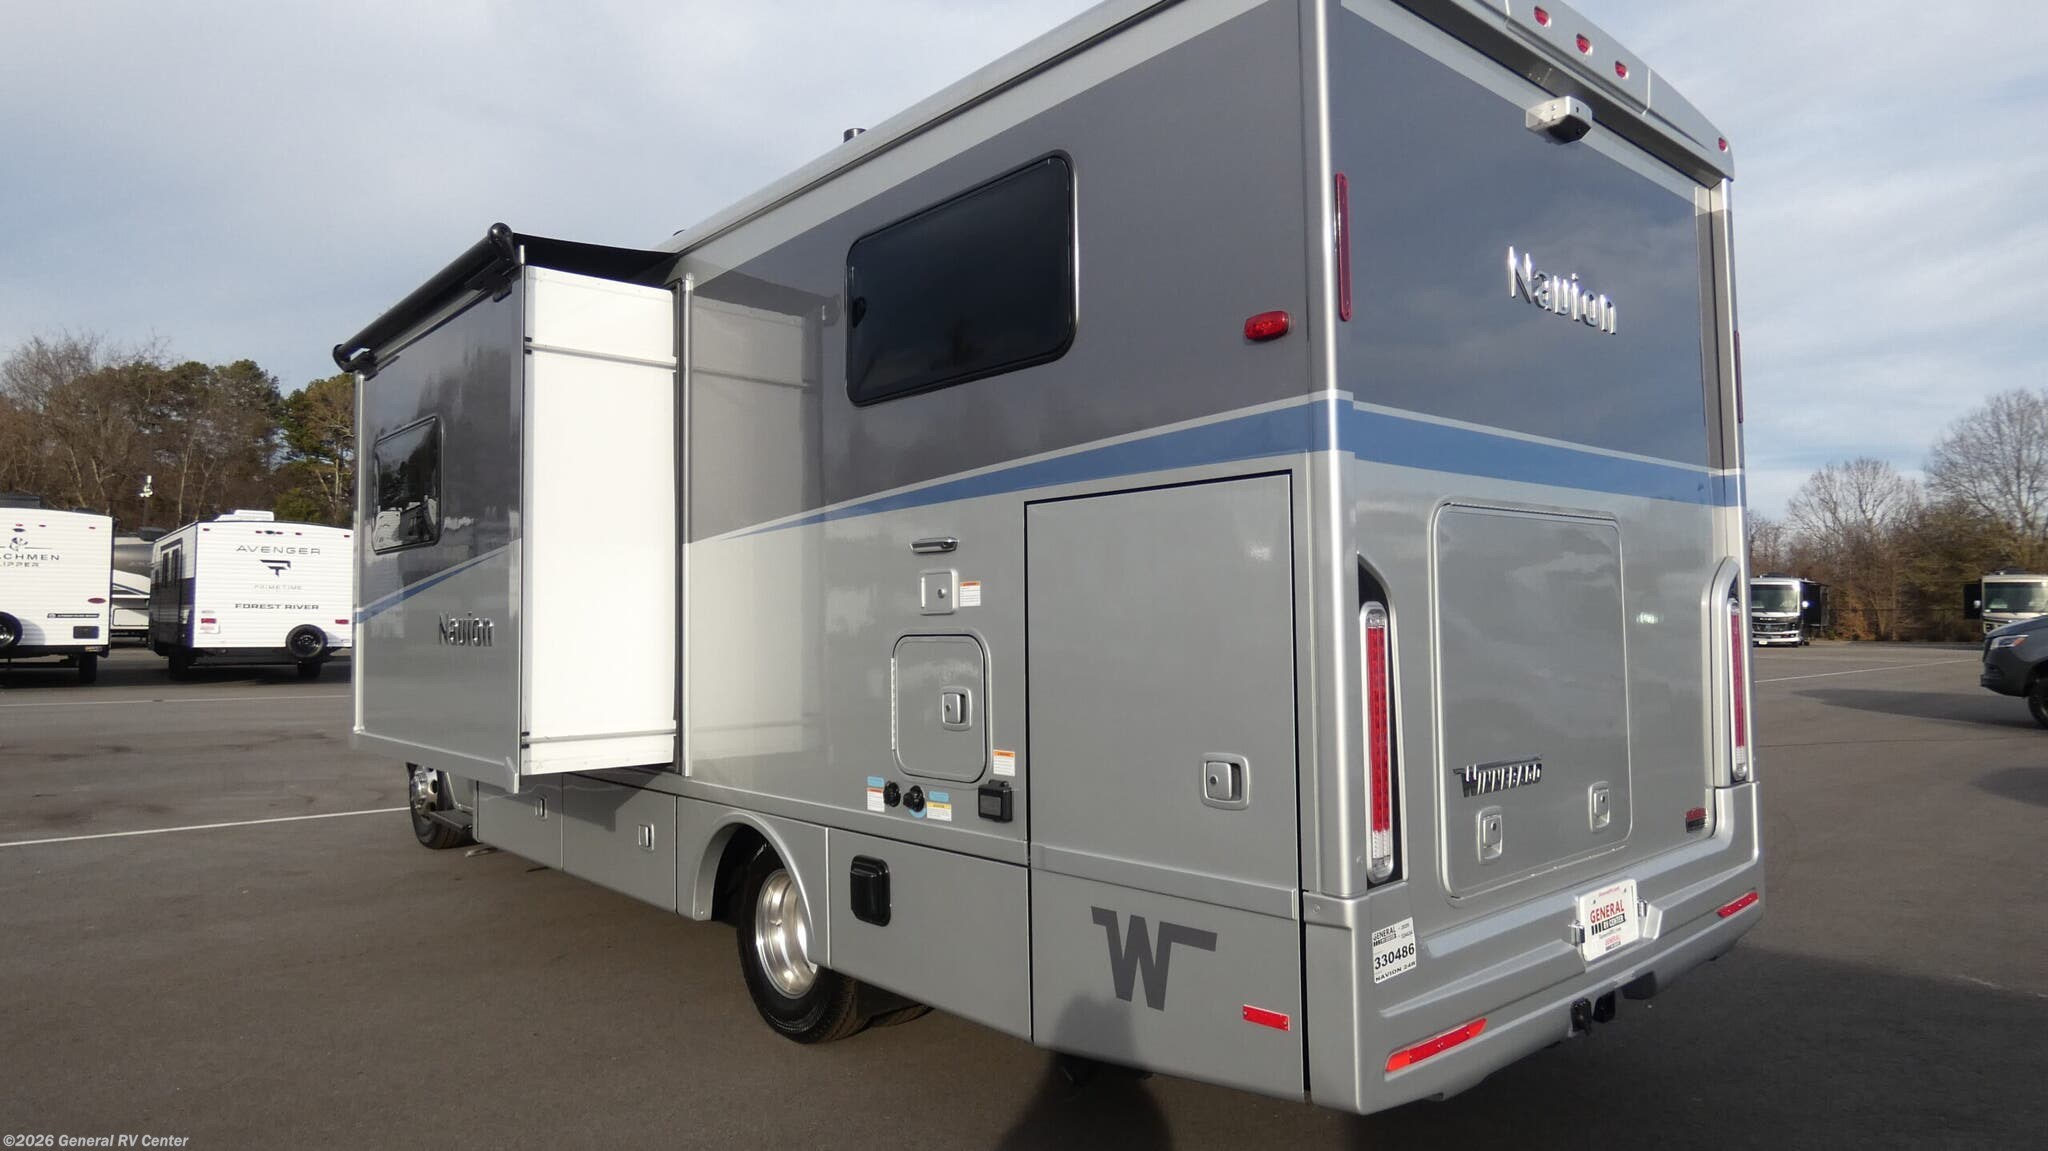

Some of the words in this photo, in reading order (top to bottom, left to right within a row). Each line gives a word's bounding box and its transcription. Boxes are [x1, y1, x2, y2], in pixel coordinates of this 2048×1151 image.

[1508, 246, 1617, 335] Navion
[0, 553, 60, 561] CHMEN
[236, 545, 321, 555] AVENGER
[439, 610, 494, 647] Navion
[1590, 900, 1624, 923] GENERAL
[1374, 942, 1415, 970] 330486
[1375, 967, 1402, 982] NAVION
